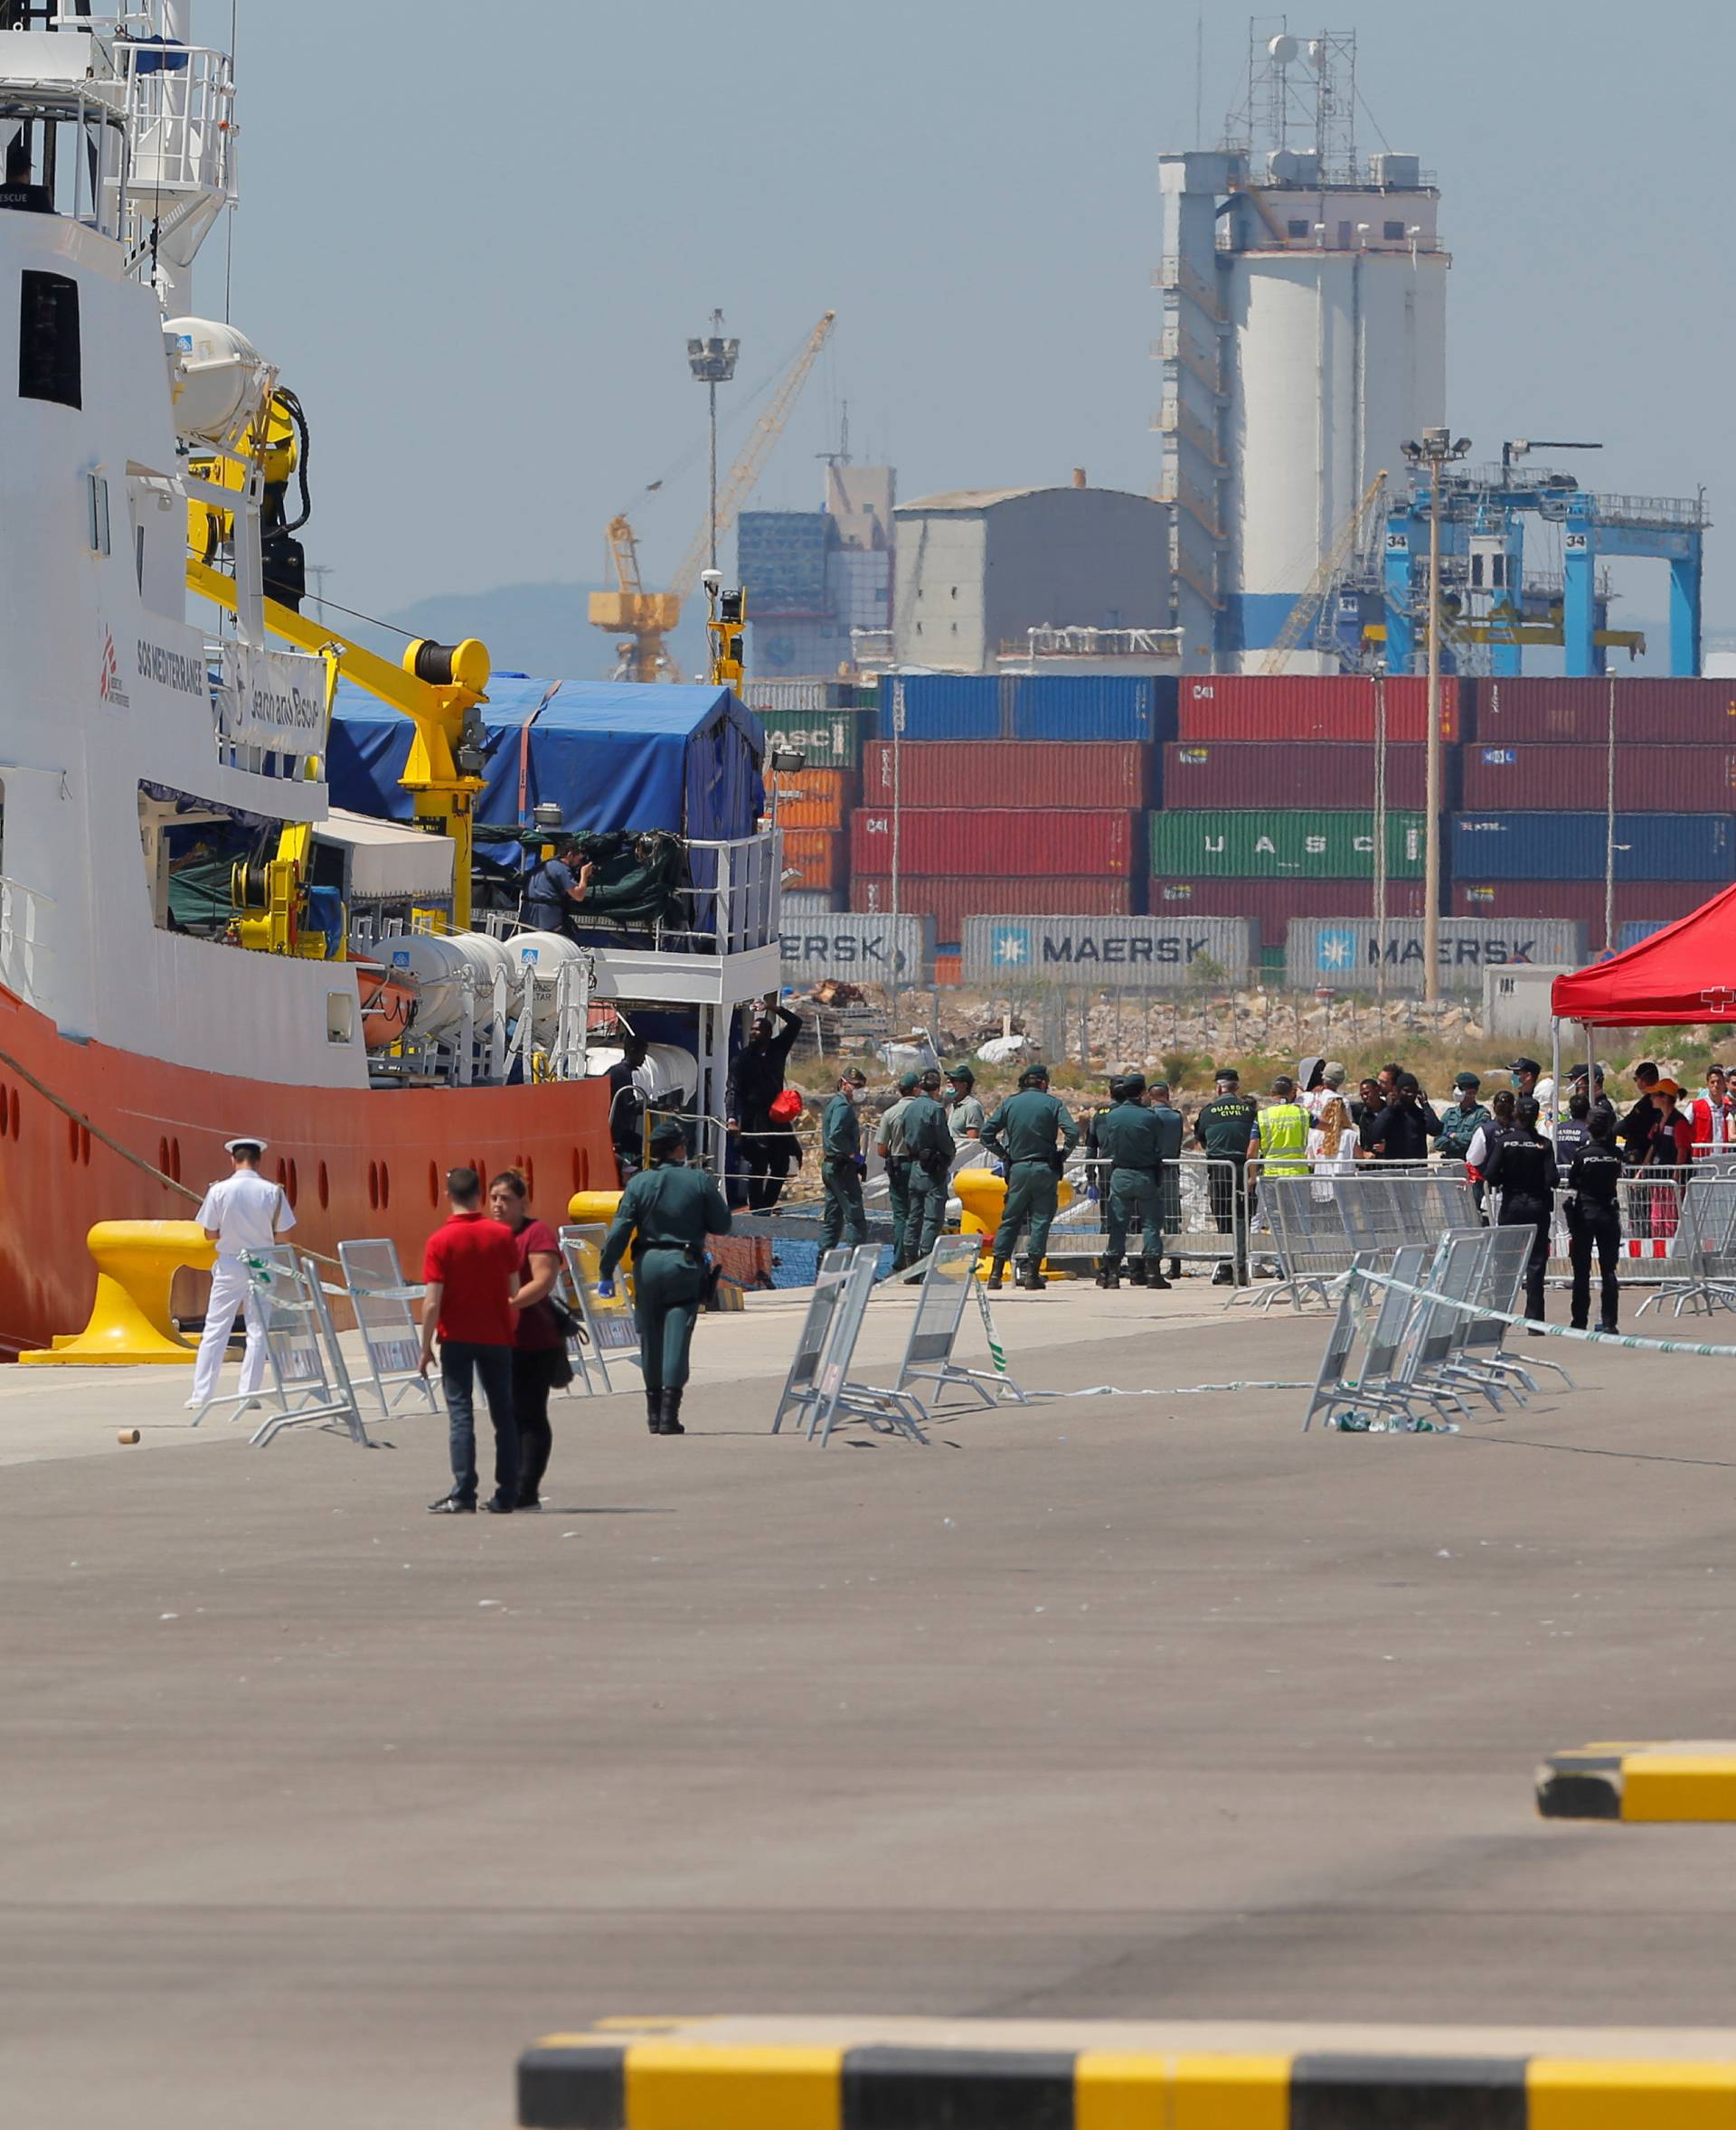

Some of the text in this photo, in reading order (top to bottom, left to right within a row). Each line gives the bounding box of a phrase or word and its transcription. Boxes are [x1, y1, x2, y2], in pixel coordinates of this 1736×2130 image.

[1388, 535, 1407, 548] 34
[1566, 535, 1587, 548] 34
[1043, 937, 1209, 963] MAERSK
[1211, 1104, 1250, 1113] GUARDIA
